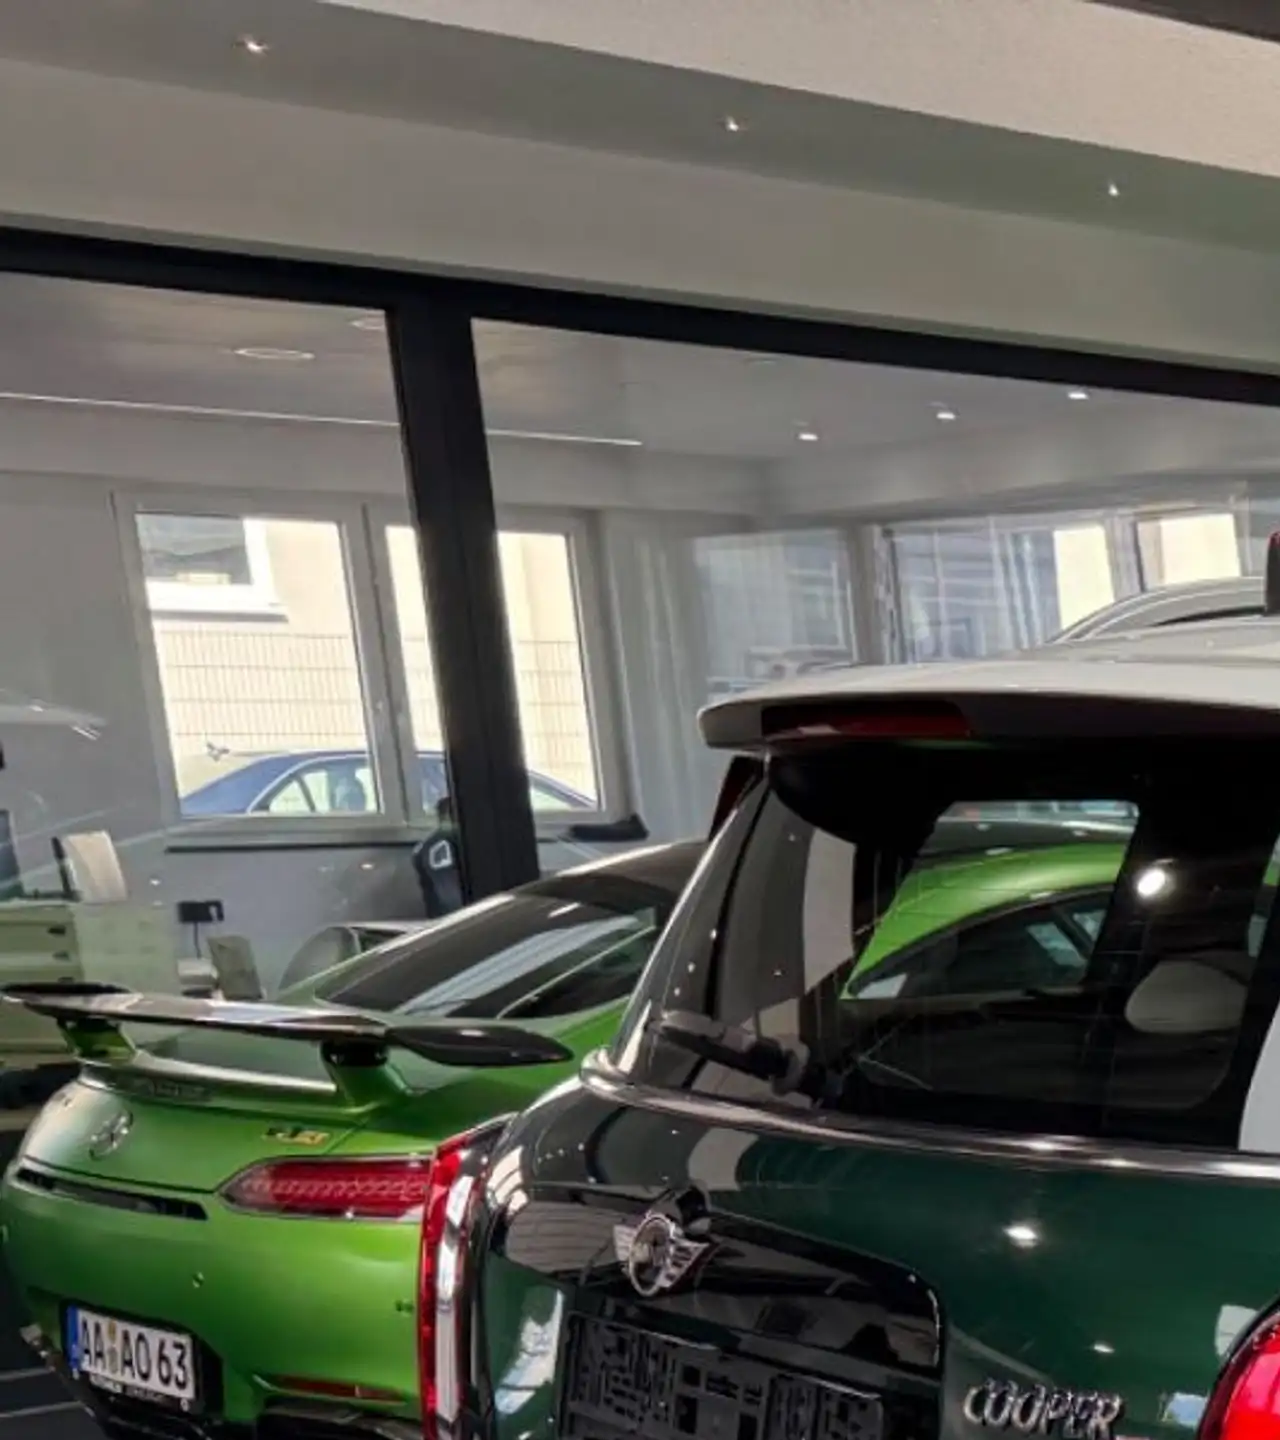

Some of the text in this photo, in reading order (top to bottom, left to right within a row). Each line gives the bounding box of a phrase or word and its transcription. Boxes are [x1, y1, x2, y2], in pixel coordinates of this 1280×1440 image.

[79, 1316, 188, 1390] AA AO 63
[963, 1377, 1122, 1440] COOPER
